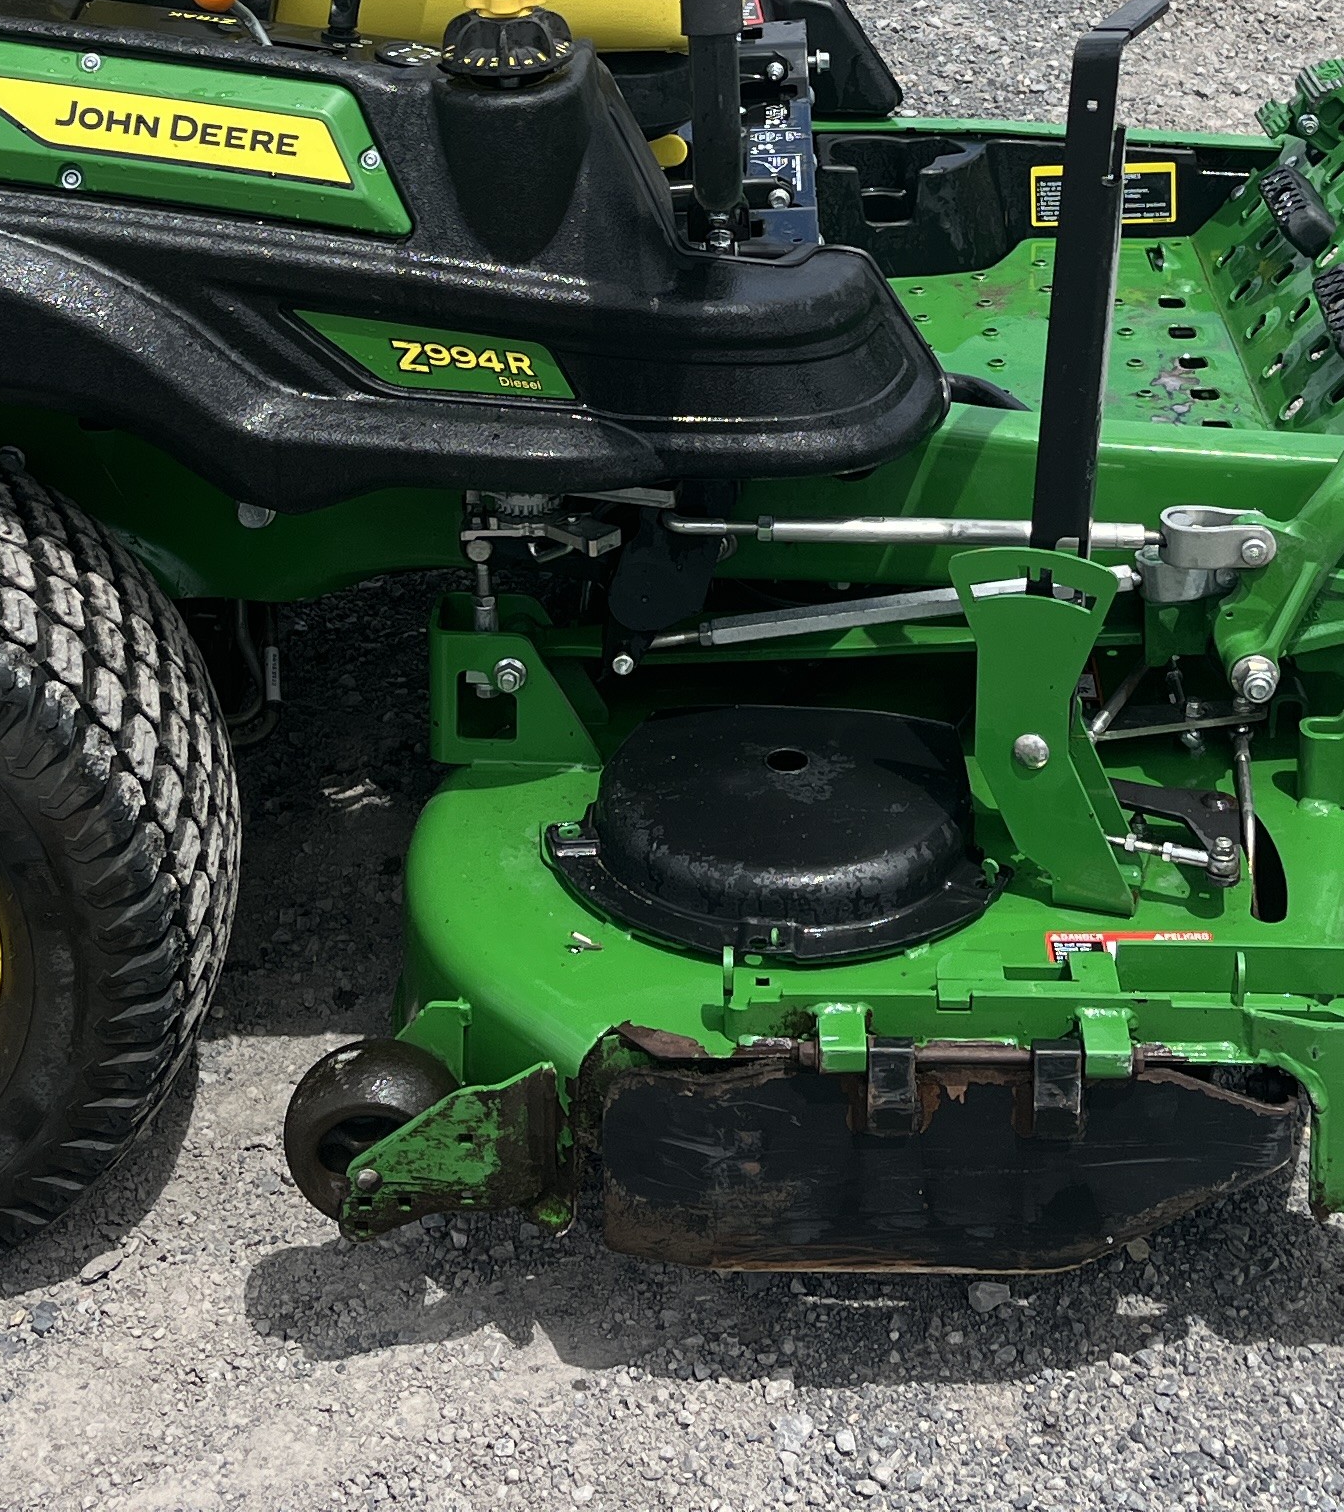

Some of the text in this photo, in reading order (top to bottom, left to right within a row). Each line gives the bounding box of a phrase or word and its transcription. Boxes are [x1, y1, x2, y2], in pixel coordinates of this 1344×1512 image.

[55, 100, 300, 157] JOHN DEERE
[391, 340, 535, 377] Z994R
[498, 376, 542, 391] Diesel
